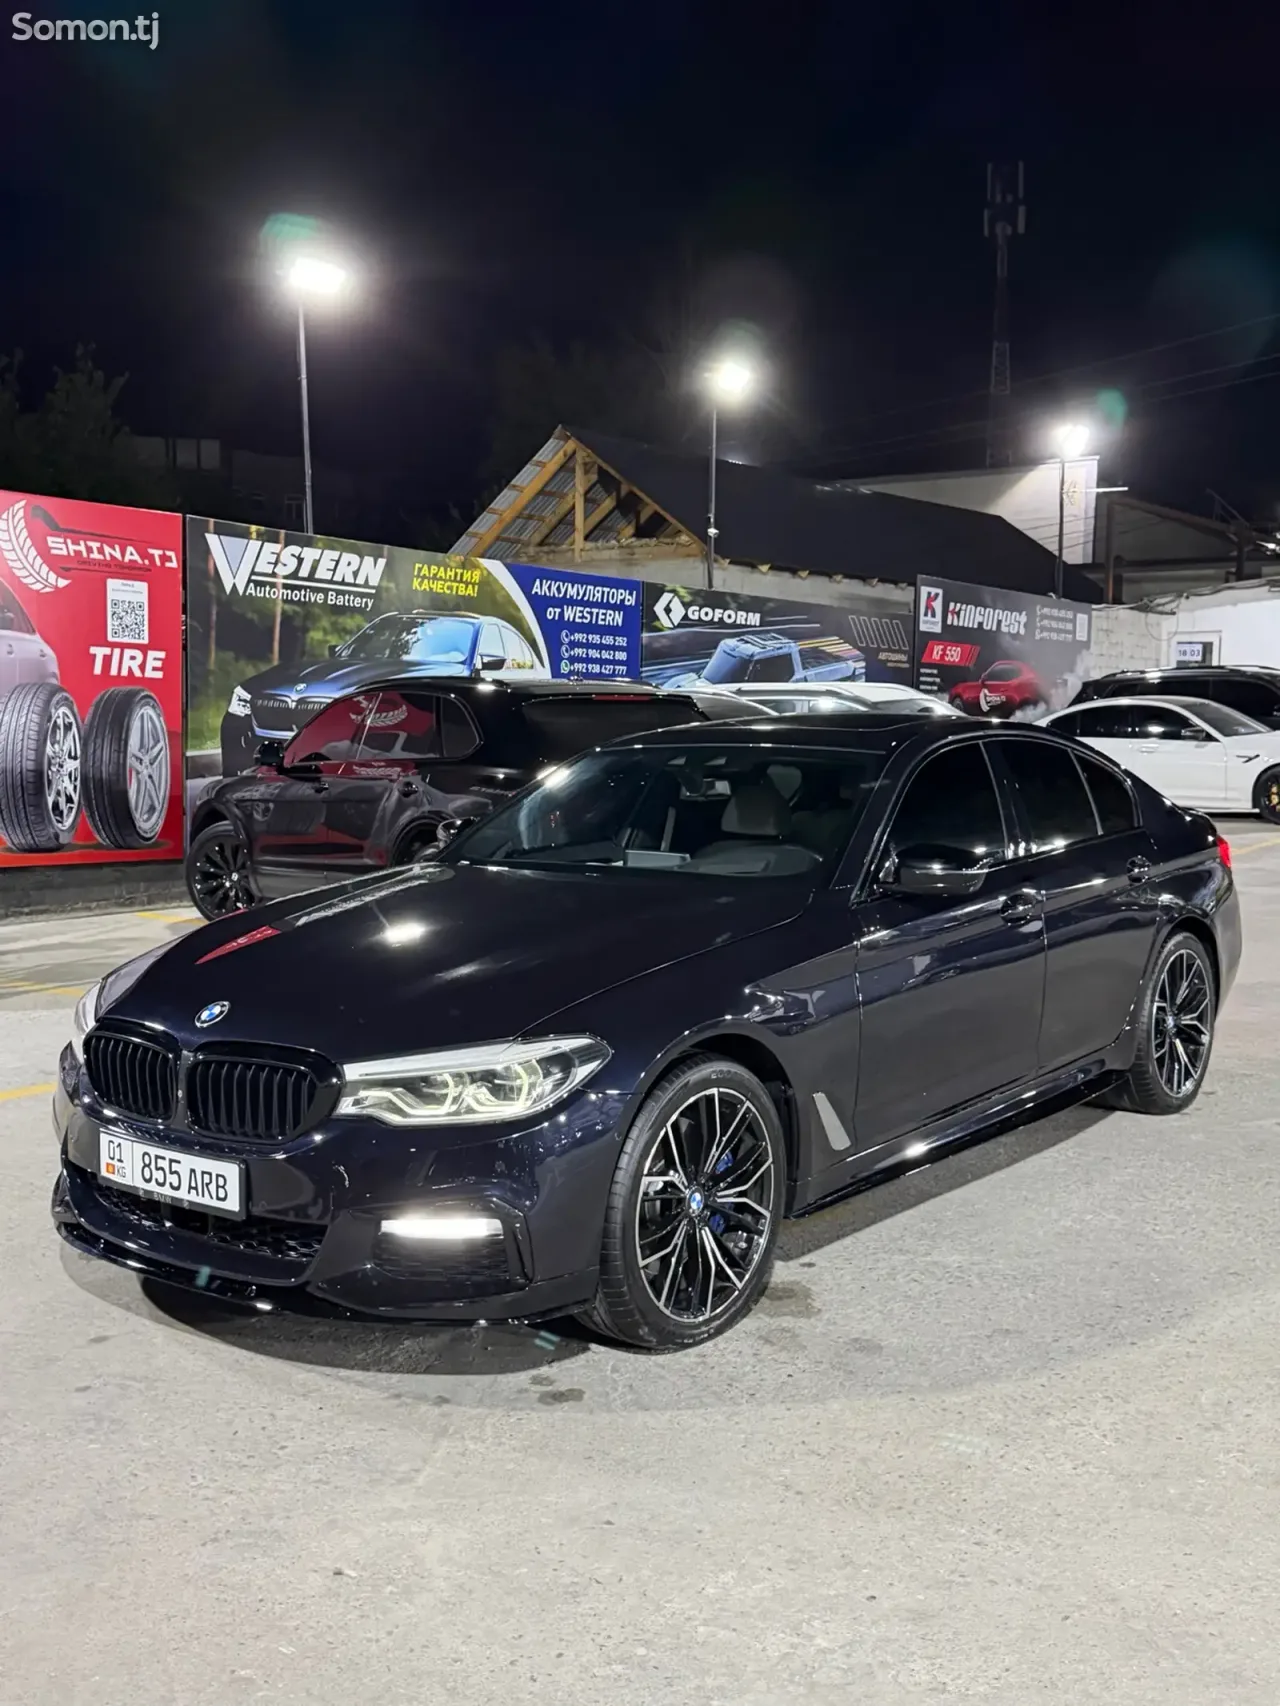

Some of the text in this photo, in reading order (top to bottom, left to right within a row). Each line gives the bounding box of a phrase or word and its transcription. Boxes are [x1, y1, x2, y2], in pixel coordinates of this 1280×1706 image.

[205, 533, 386, 596] WESTERN
[414, 563, 480, 583] ГАРАНТИЯ
[246, 582, 374, 611] Automotive Battery
[412, 577, 478, 598] КАЧЕСТВА!
[531, 578, 637, 607] АККУМУЛЯТОРЫ
[546, 605, 623, 627] от WESTERN
[687, 605, 761, 627] GOFORM
[570, 632, 628, 646] +992 935 455 252
[90, 646, 166, 678] TIRE
[570, 647, 587, 658] +992
[588, 649, 601, 659] 904
[601, 650, 614, 660] 042
[932, 645, 961, 662] KF 550
[570, 662, 628, 675] +992 938 427 777
[116, 1165, 126, 1178] KG
[141, 1152, 228, 1201] 855 ARB
